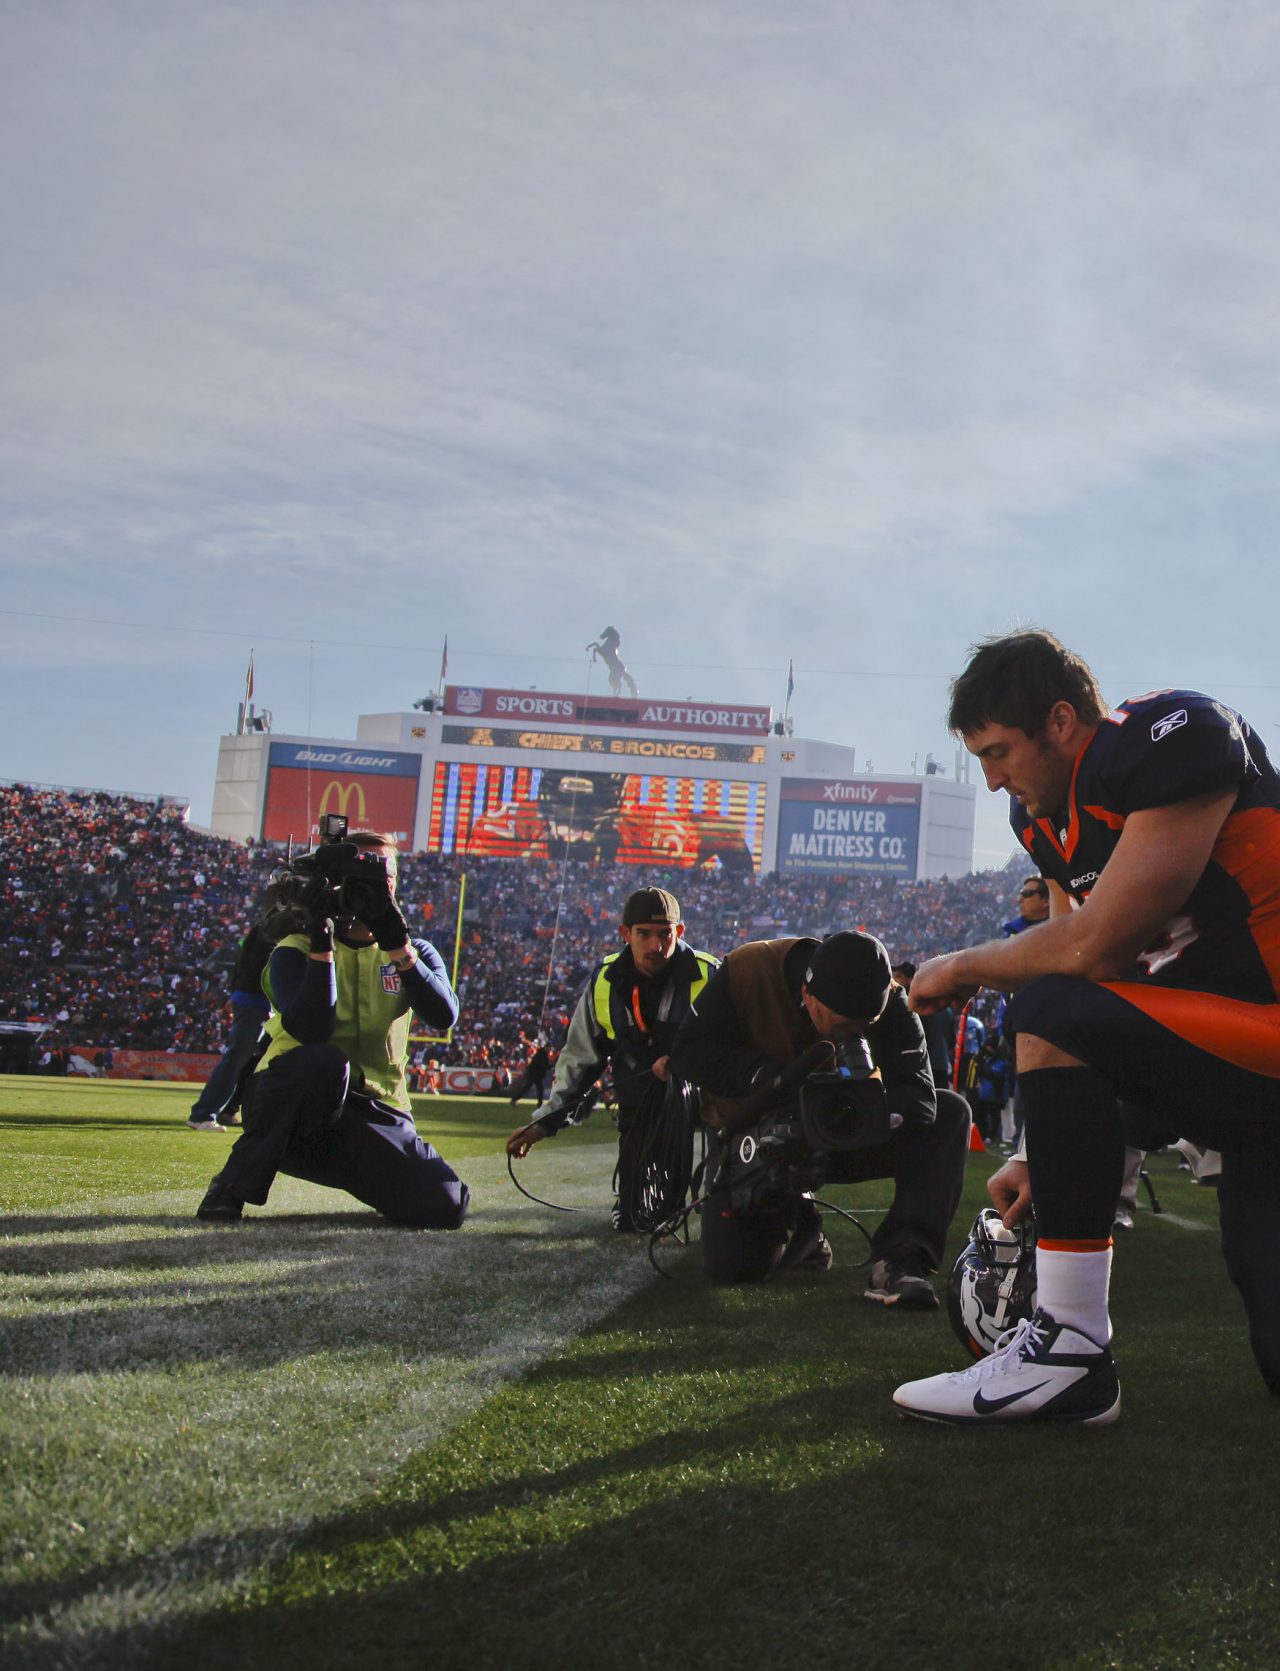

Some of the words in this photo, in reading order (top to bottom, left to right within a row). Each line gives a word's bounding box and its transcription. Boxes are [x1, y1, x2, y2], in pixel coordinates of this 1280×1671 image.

[496, 696, 573, 716] SPORTS
[642, 706, 767, 730] AUTHORITY
[520, 732, 583, 751] CHIEFS
[610, 742, 716, 760] BRONCOS
[295, 750, 337, 761] BUD
[341, 752, 396, 768] LIGHT
[824, 783, 878, 803] xfinity
[813, 808, 886, 833] DENVER
[789, 833, 874, 858] MATTRESS
